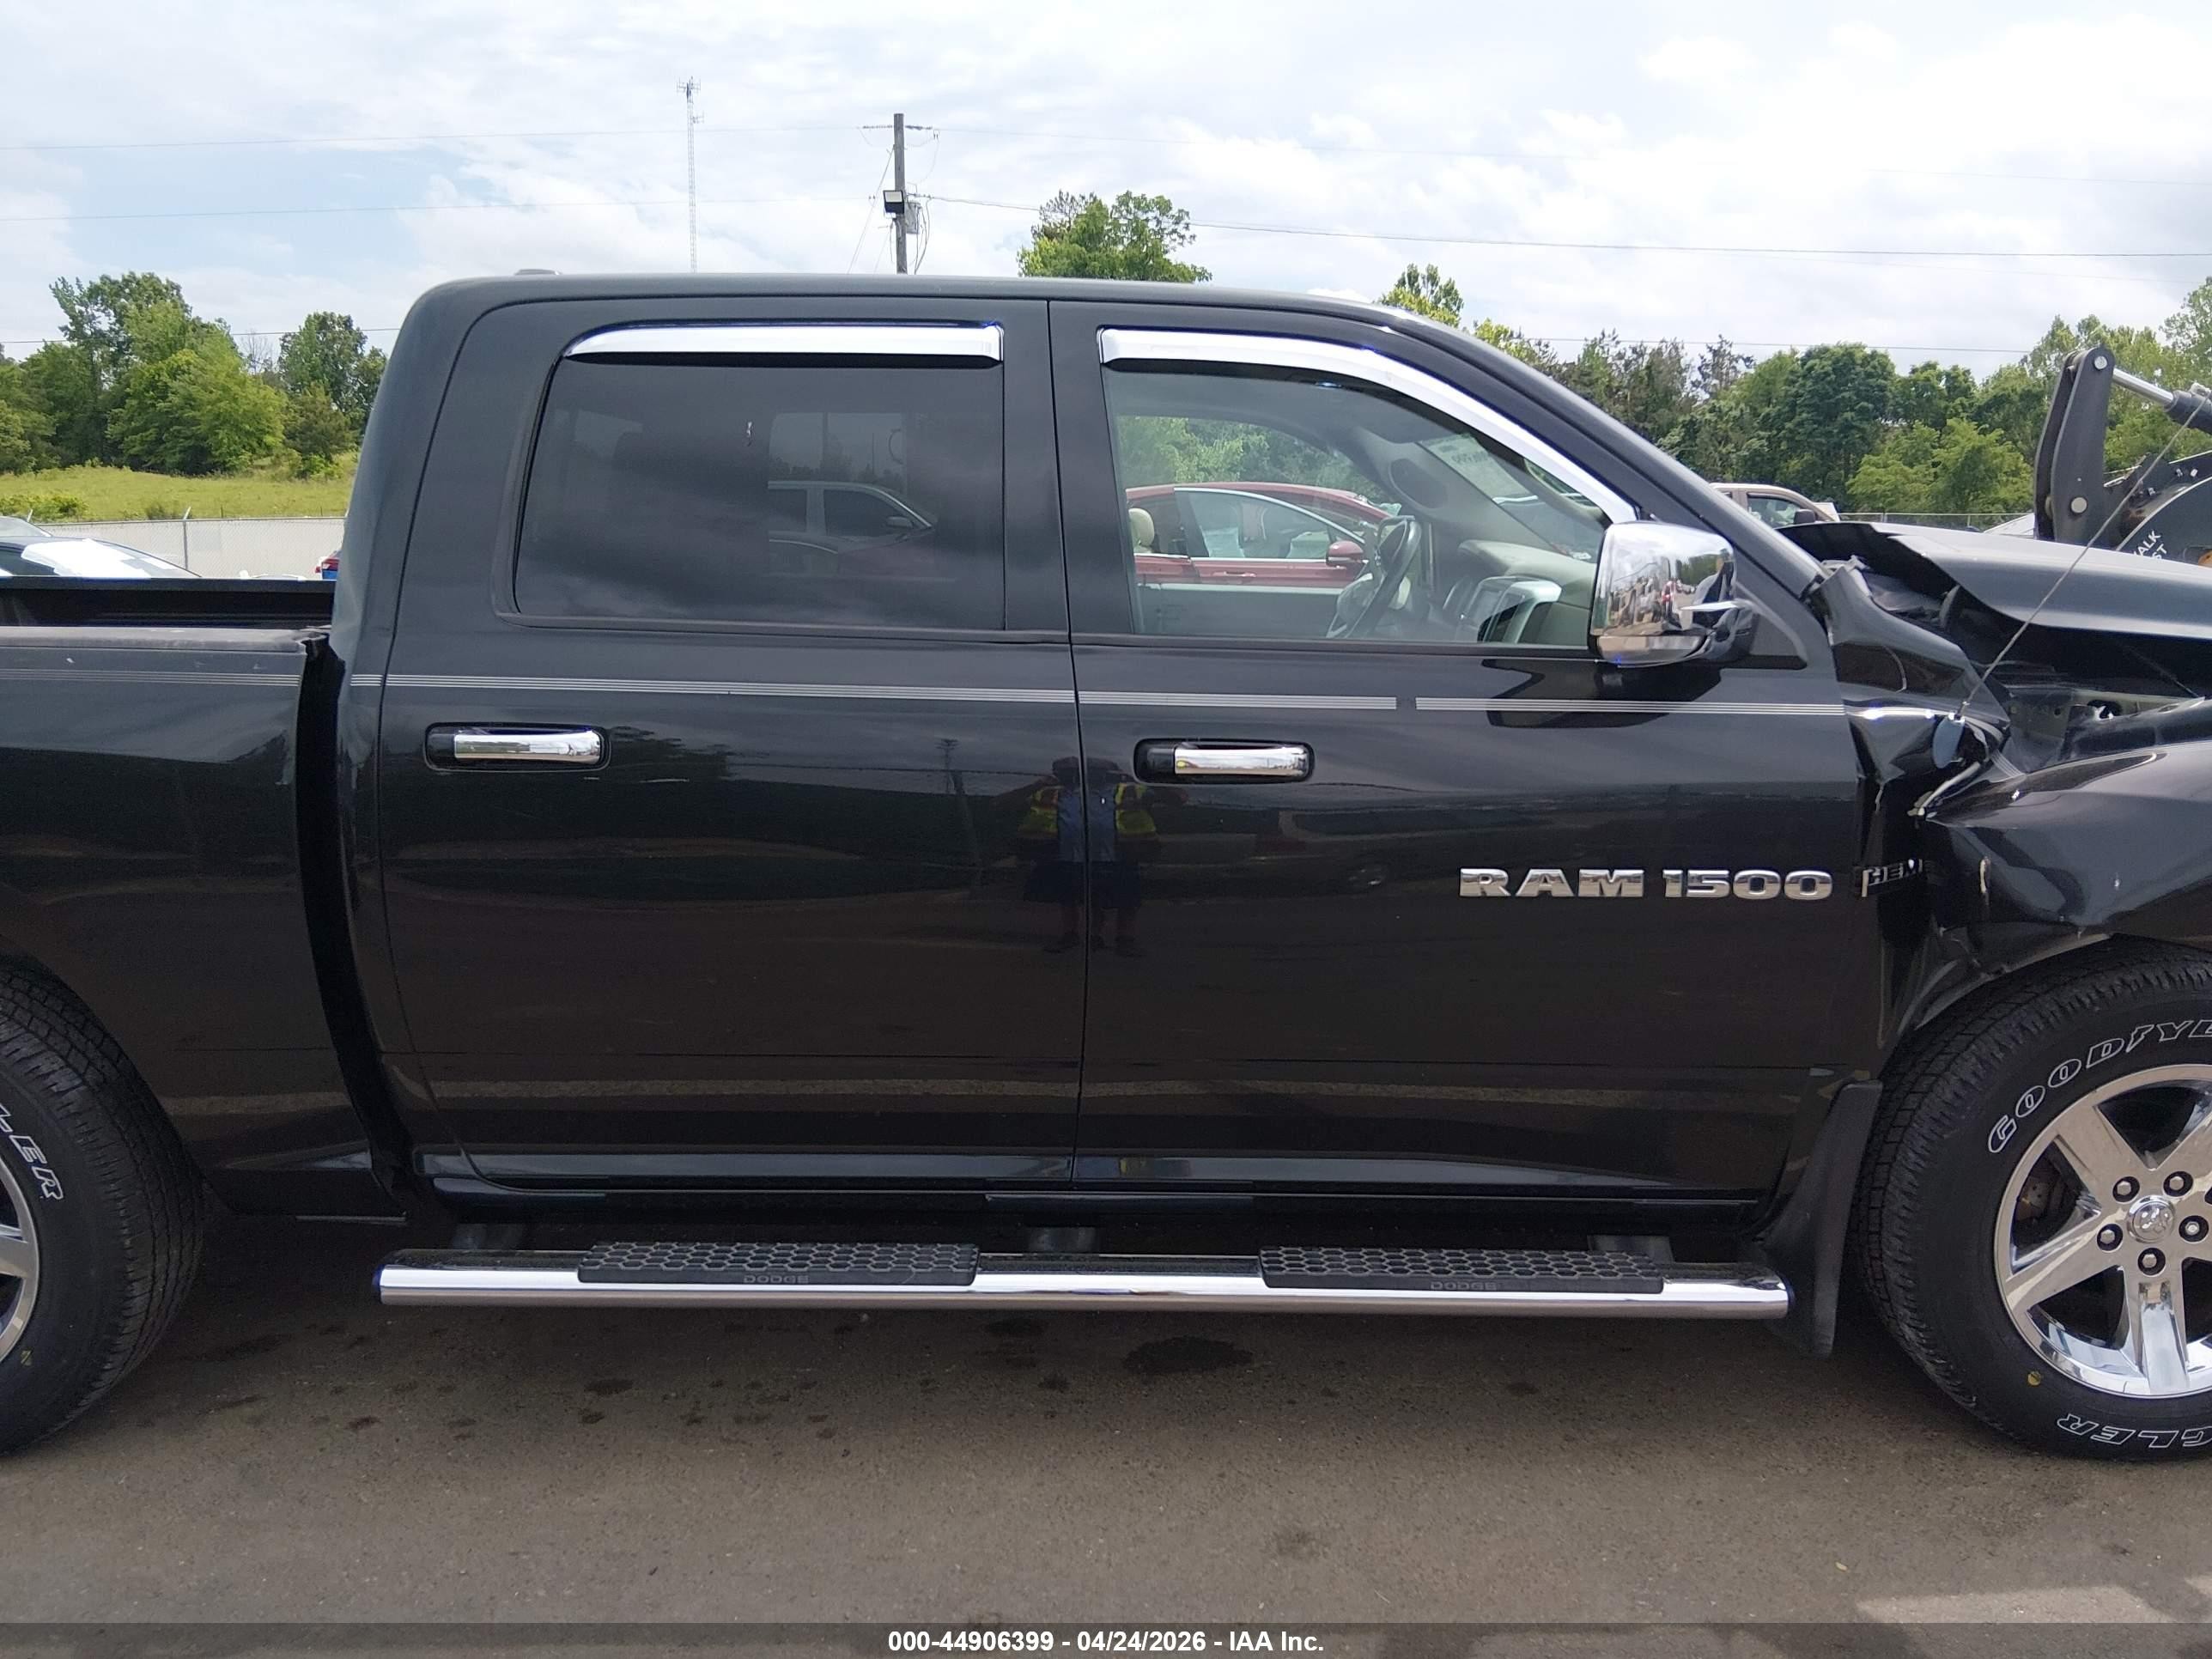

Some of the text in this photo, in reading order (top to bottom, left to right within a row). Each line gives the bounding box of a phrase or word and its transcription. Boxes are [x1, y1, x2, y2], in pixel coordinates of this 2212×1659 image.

[2133, 530, 2161, 556] ALK
[1459, 868, 1832, 901] RAM 1500
[744, 1274, 809, 1284] DODGE
[1430, 1281, 1497, 1291] DODGE
